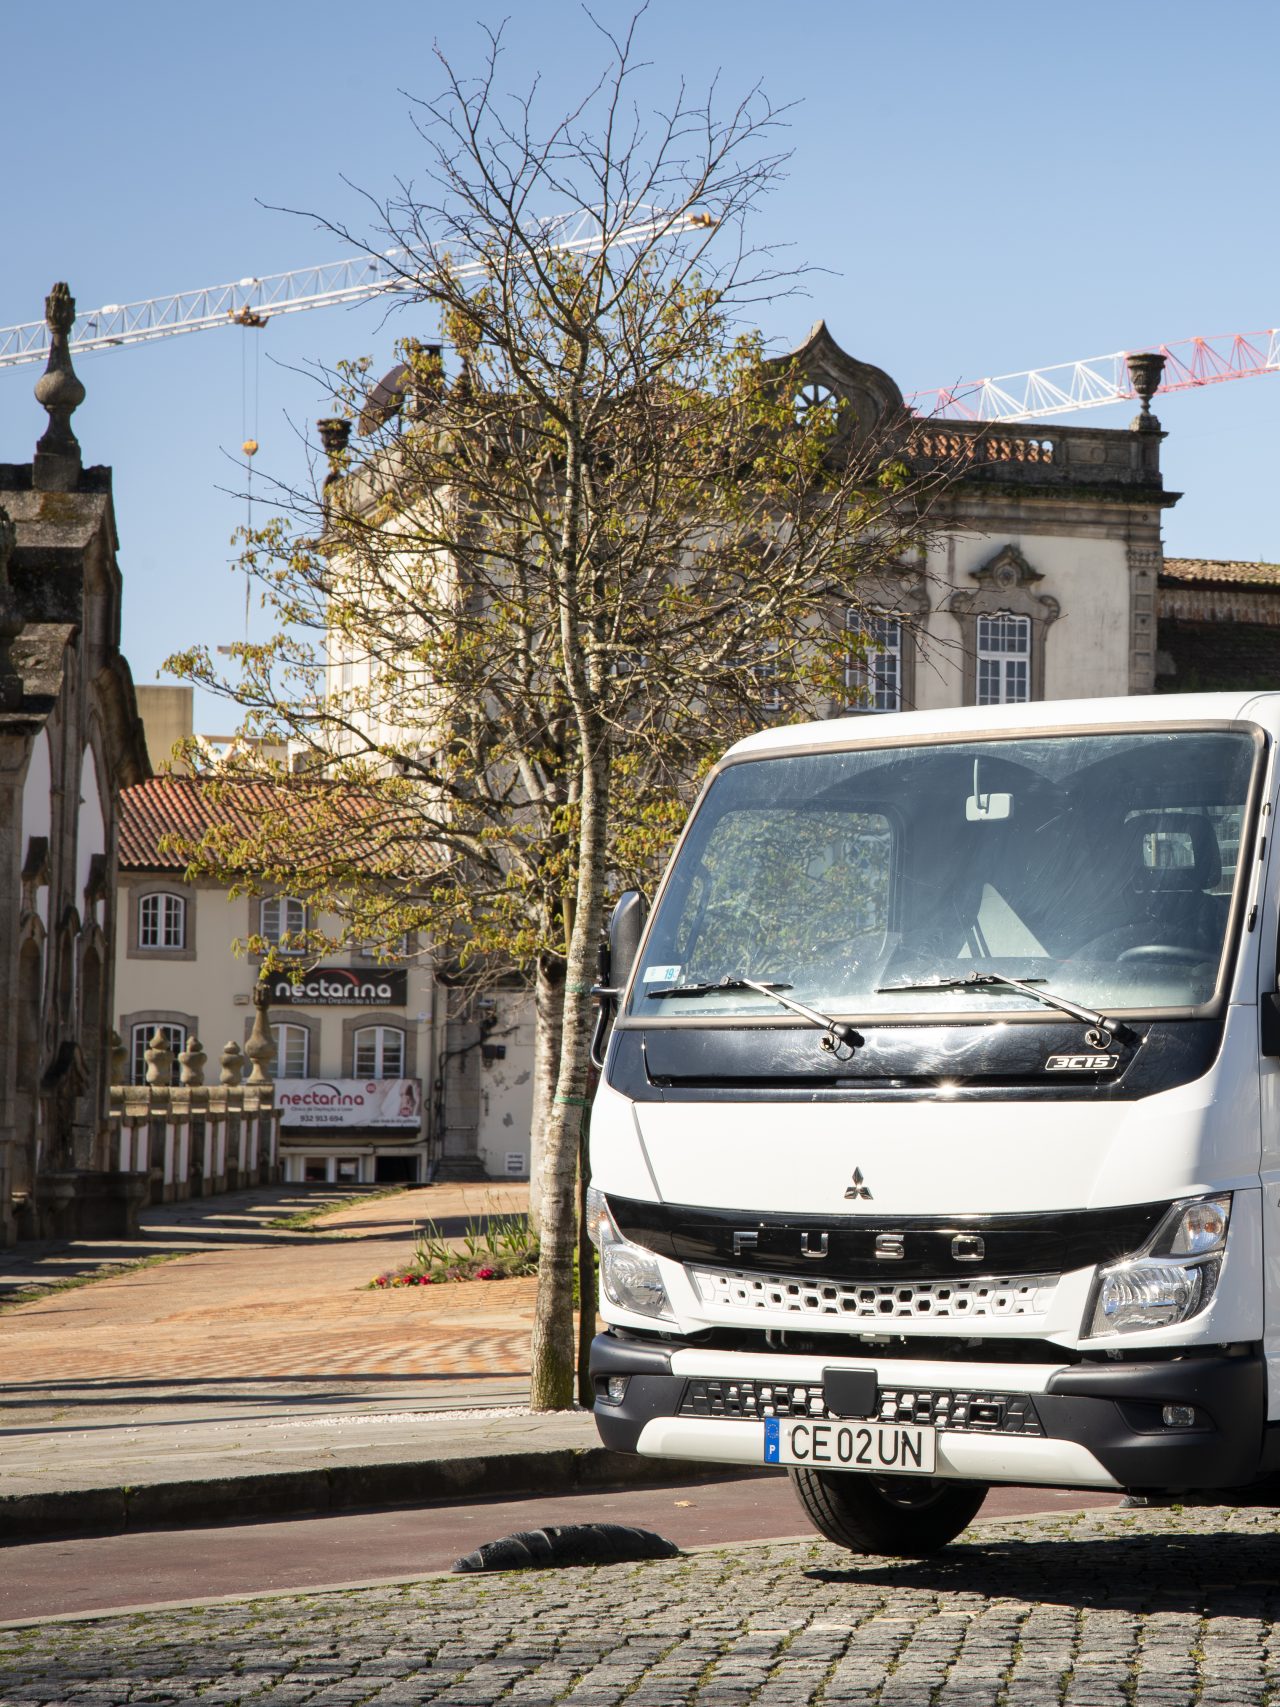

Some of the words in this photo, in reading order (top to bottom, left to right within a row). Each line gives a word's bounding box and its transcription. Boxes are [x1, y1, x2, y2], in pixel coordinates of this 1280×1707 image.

[275, 979, 391, 997] nectarina
[1053, 1057, 1110, 1068] 3C15
[280, 1091, 365, 1105] nectarina
[733, 1231, 985, 1262] FUSO
[769, 1444, 776, 1455] P
